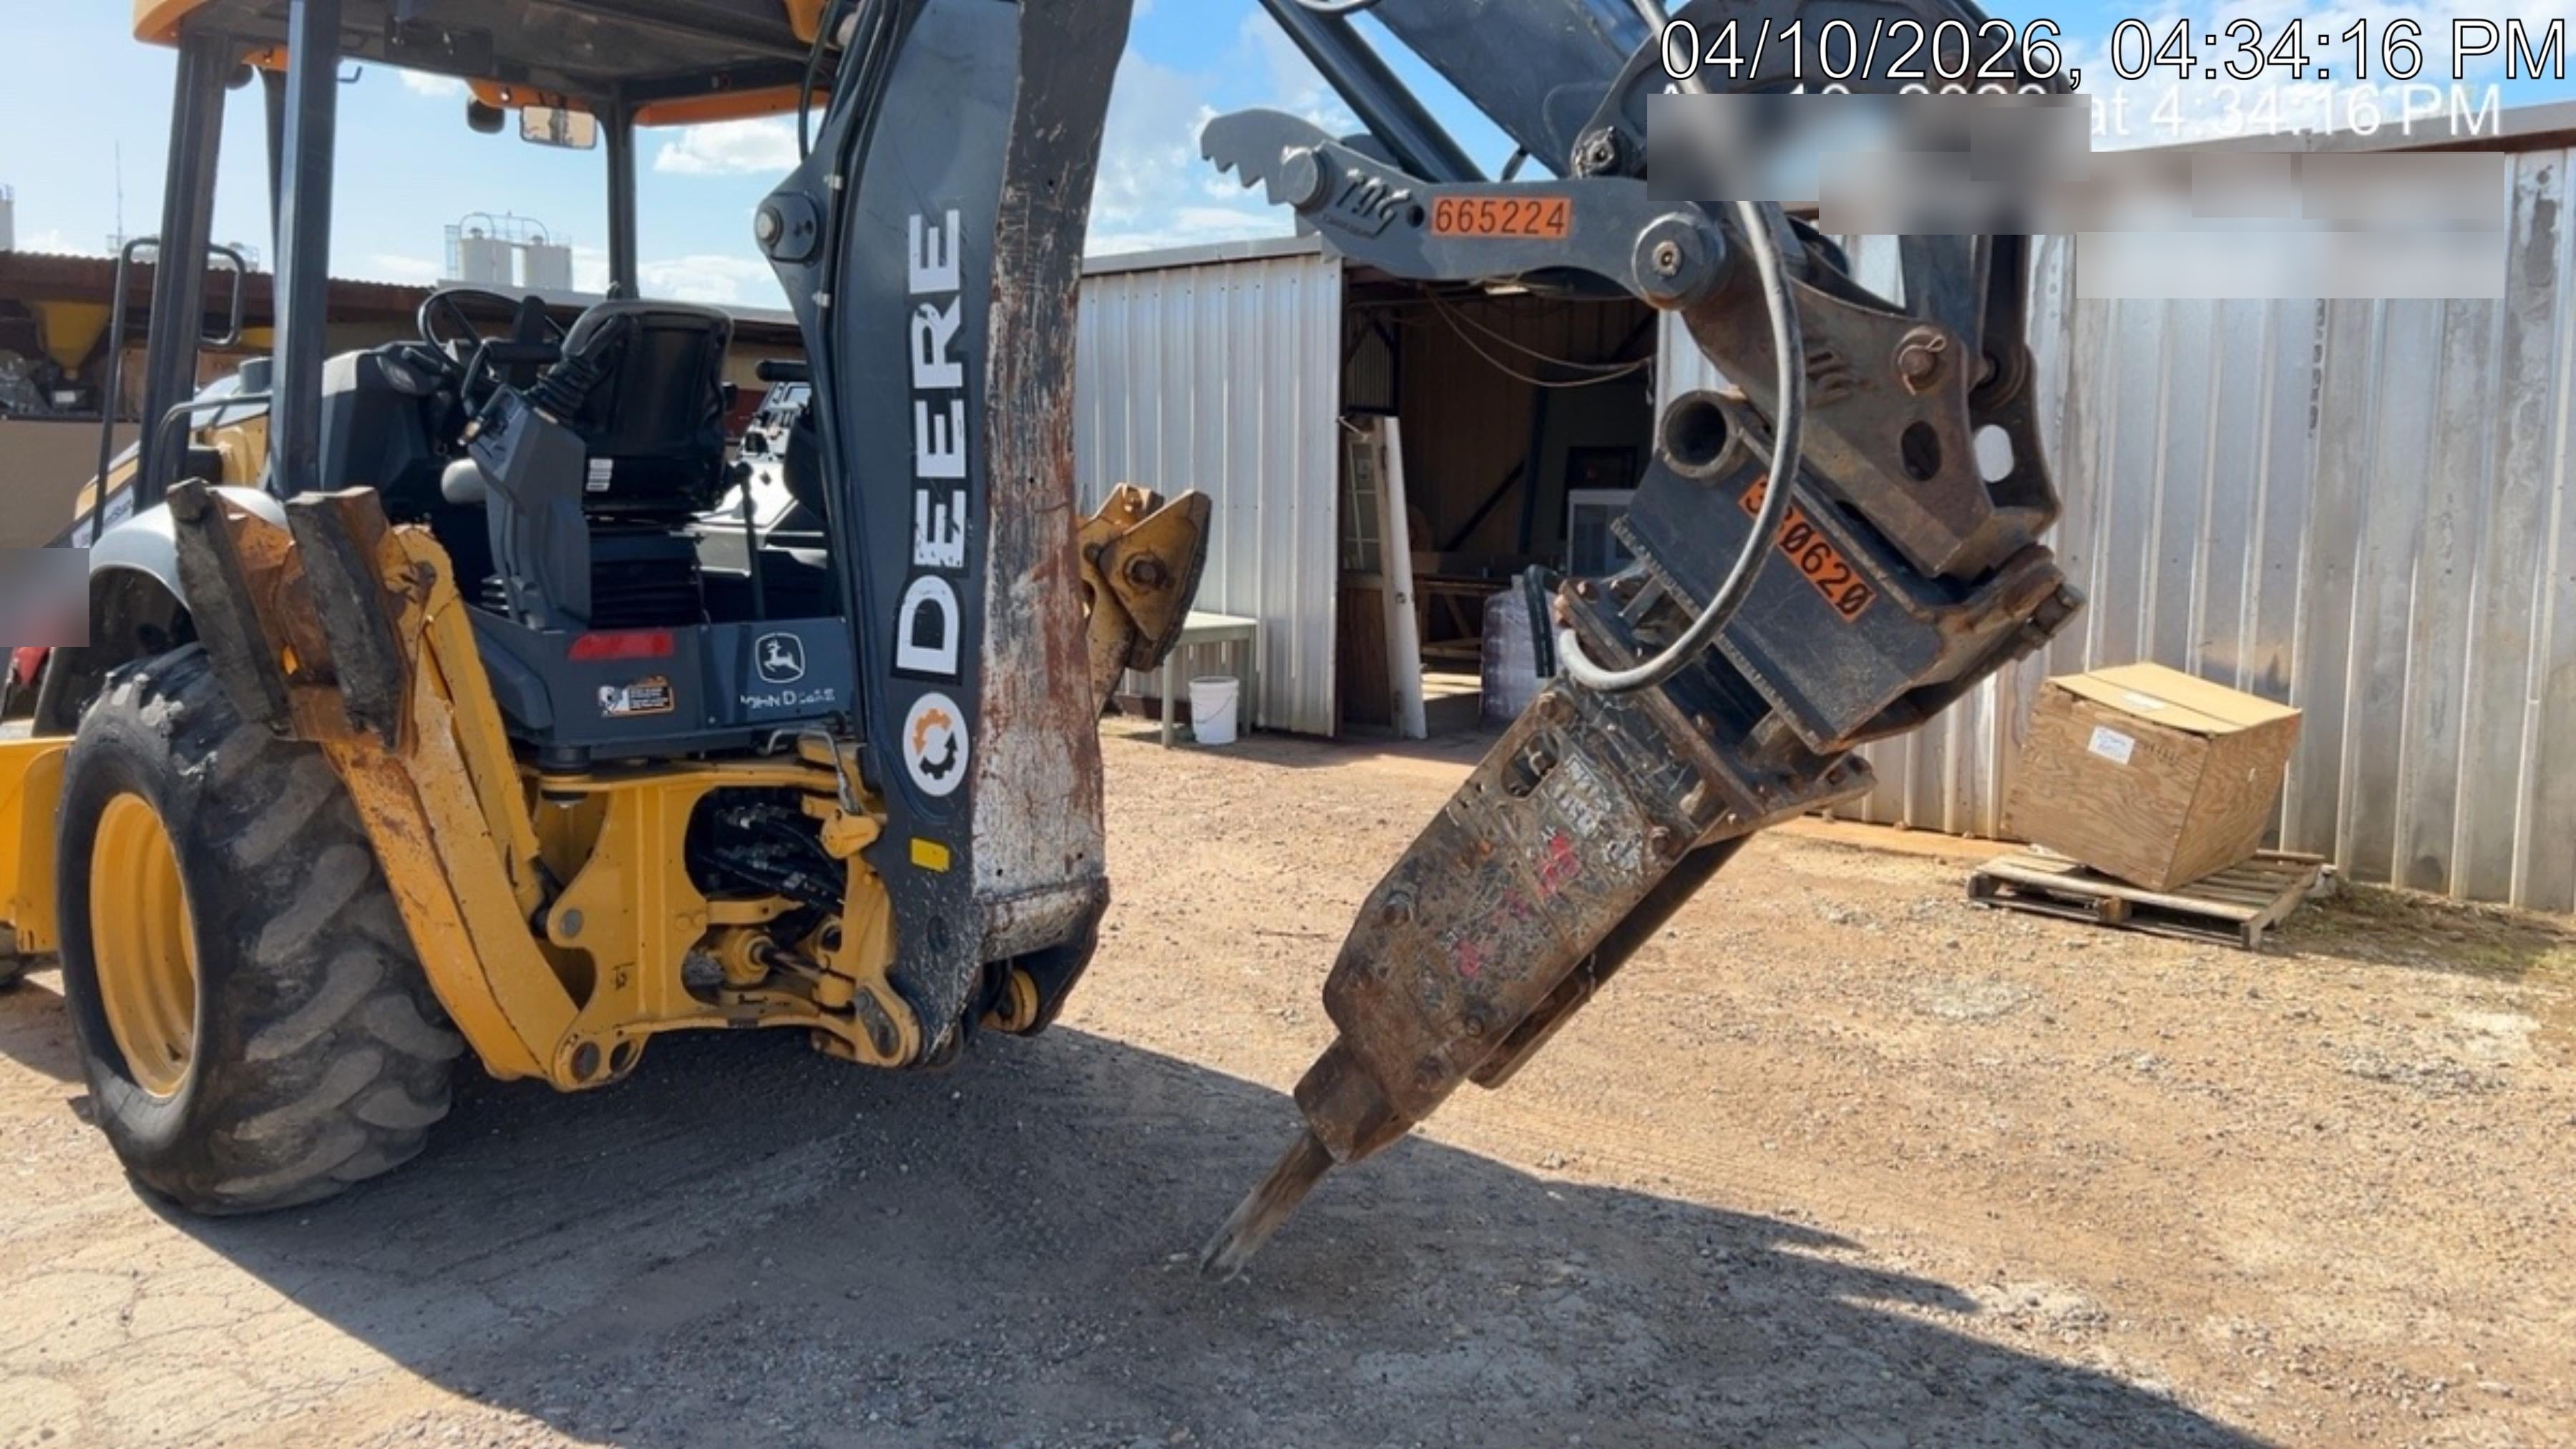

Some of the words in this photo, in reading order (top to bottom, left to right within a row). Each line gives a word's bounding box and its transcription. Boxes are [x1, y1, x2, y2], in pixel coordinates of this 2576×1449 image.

[1435, 198, 1566, 235] 665224
[896, 209, 967, 675] DEERE
[1745, 481, 1874, 615] 30620
